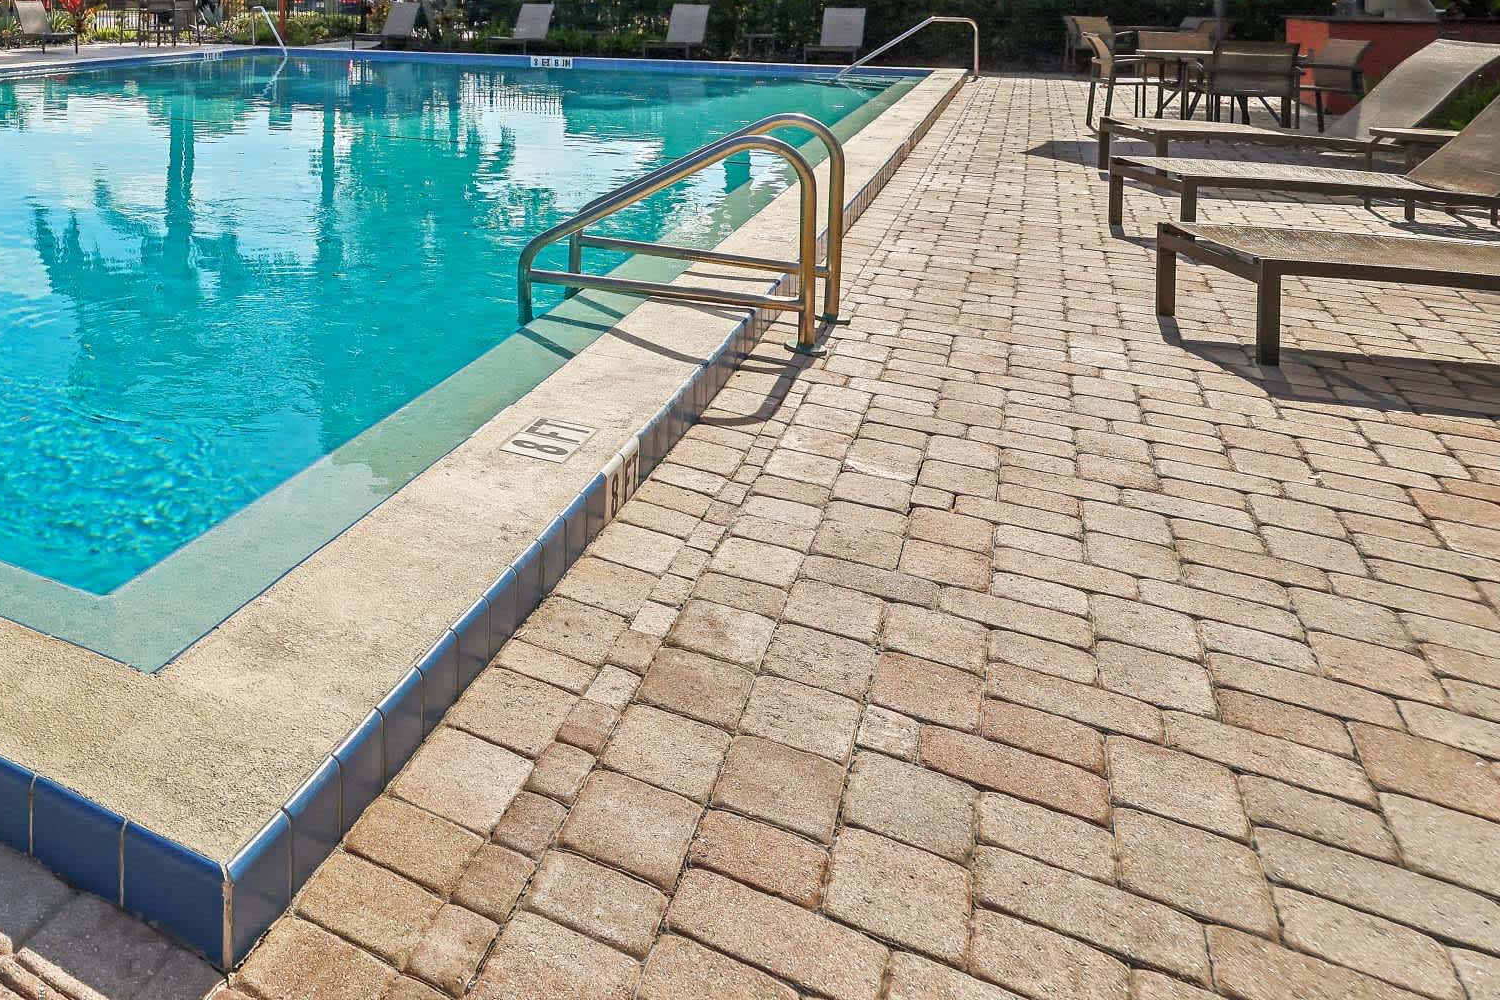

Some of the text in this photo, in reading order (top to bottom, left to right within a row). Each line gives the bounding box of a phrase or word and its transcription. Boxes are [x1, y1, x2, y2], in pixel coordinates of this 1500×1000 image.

[512, 418, 590, 456] 8 FT
[611, 450, 639, 519] 8 FT
